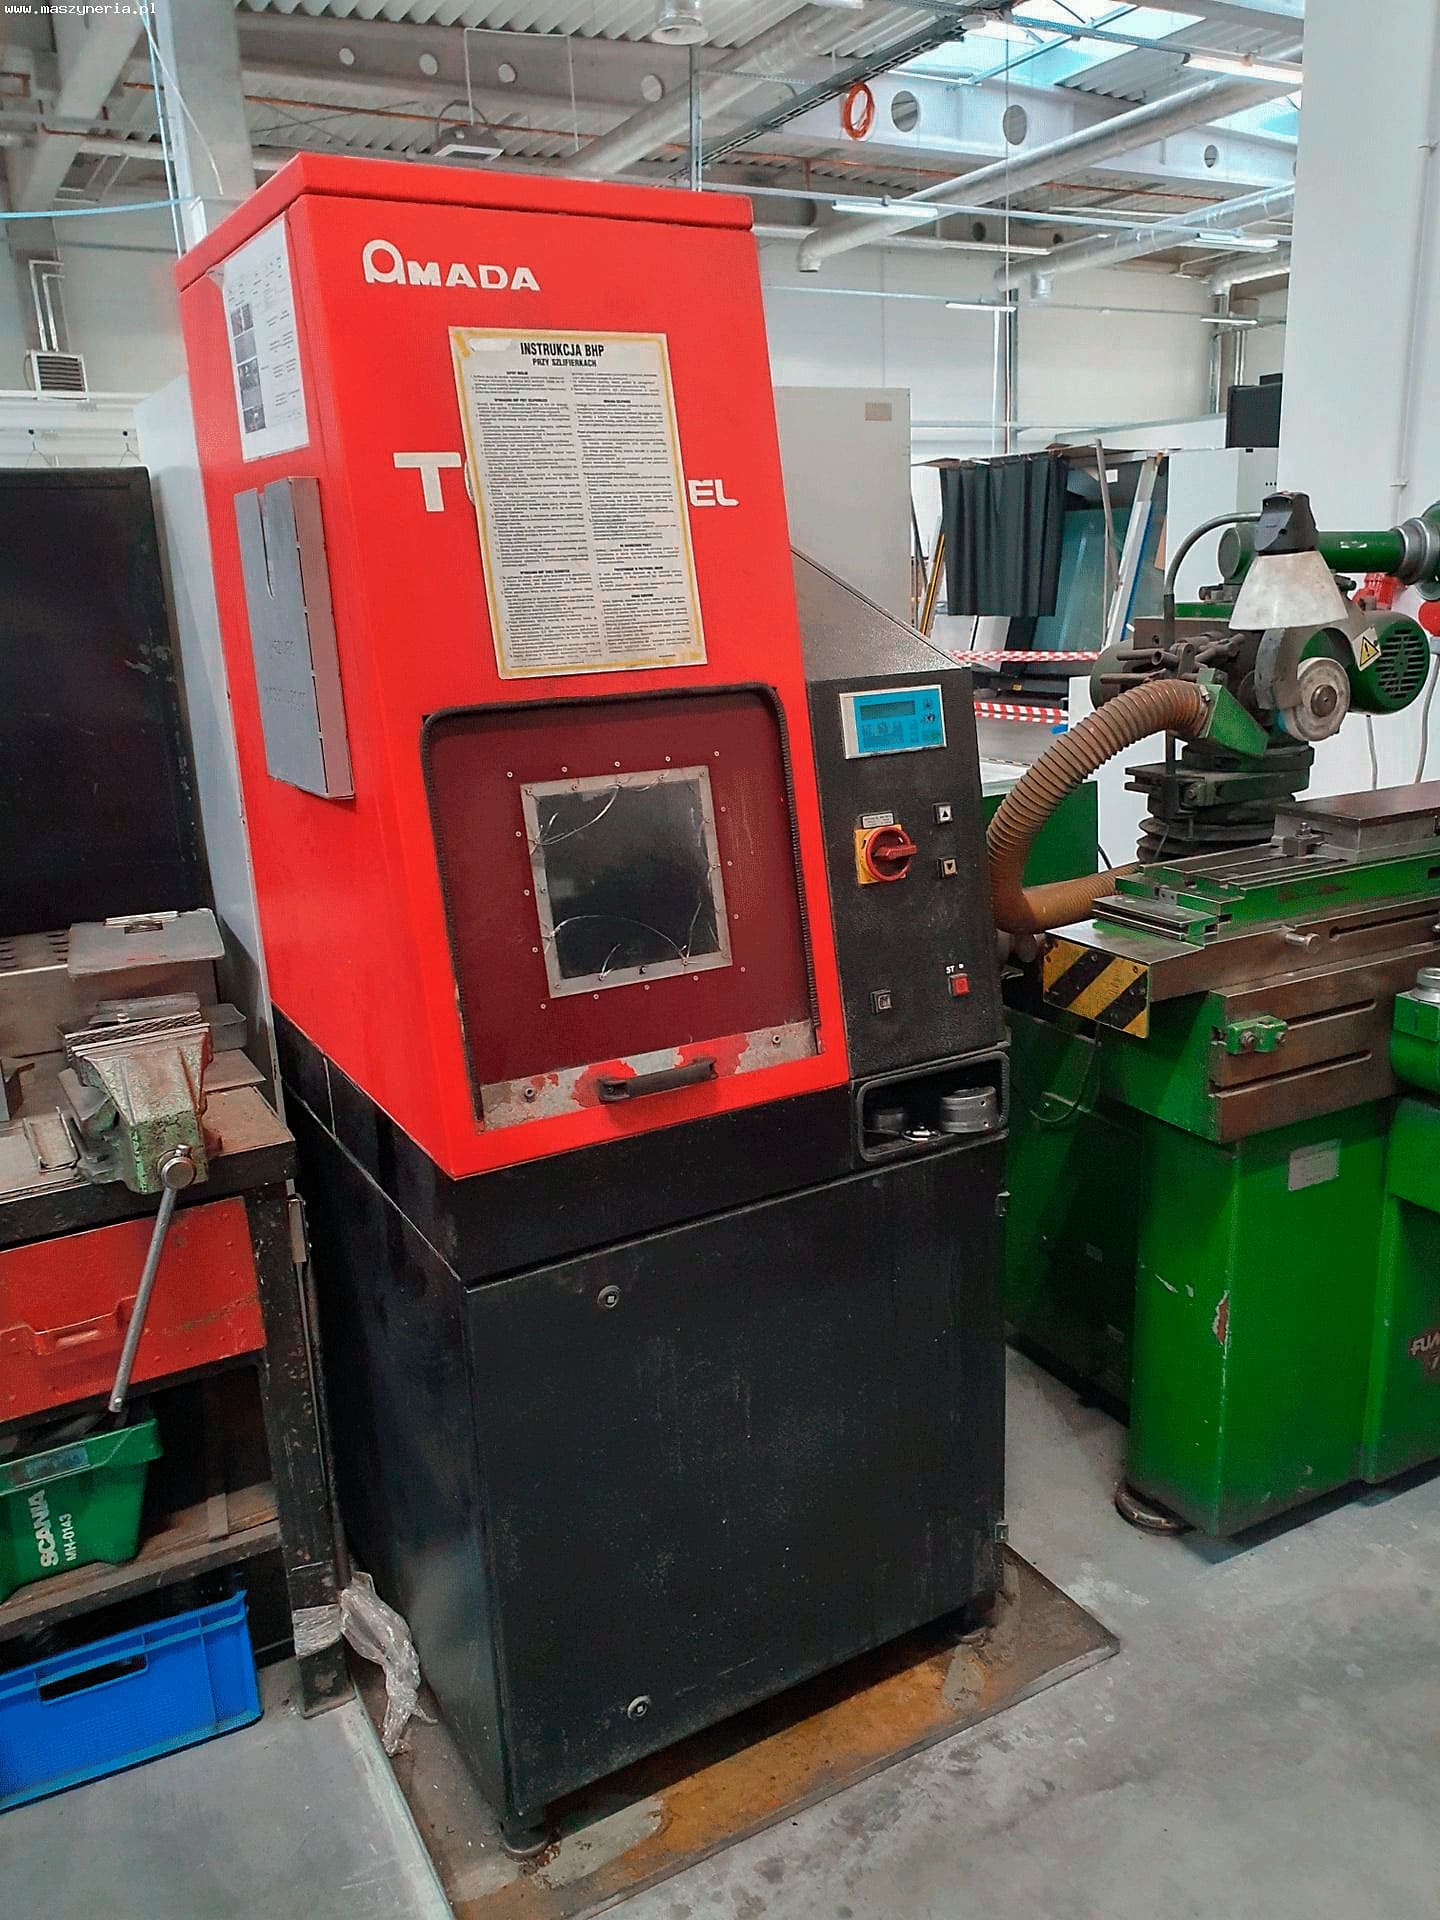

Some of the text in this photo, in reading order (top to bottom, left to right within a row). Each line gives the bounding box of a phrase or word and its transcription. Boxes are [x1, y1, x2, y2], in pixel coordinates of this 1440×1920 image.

[362, 239, 541, 291] AMADA
[520, 342, 605, 357] INSTRUKCJA BHP
[532, 358, 549, 366] PRZY
[28, 1489, 59, 1567] SCANIA
[59, 1513, 77, 1562] MH-0143
